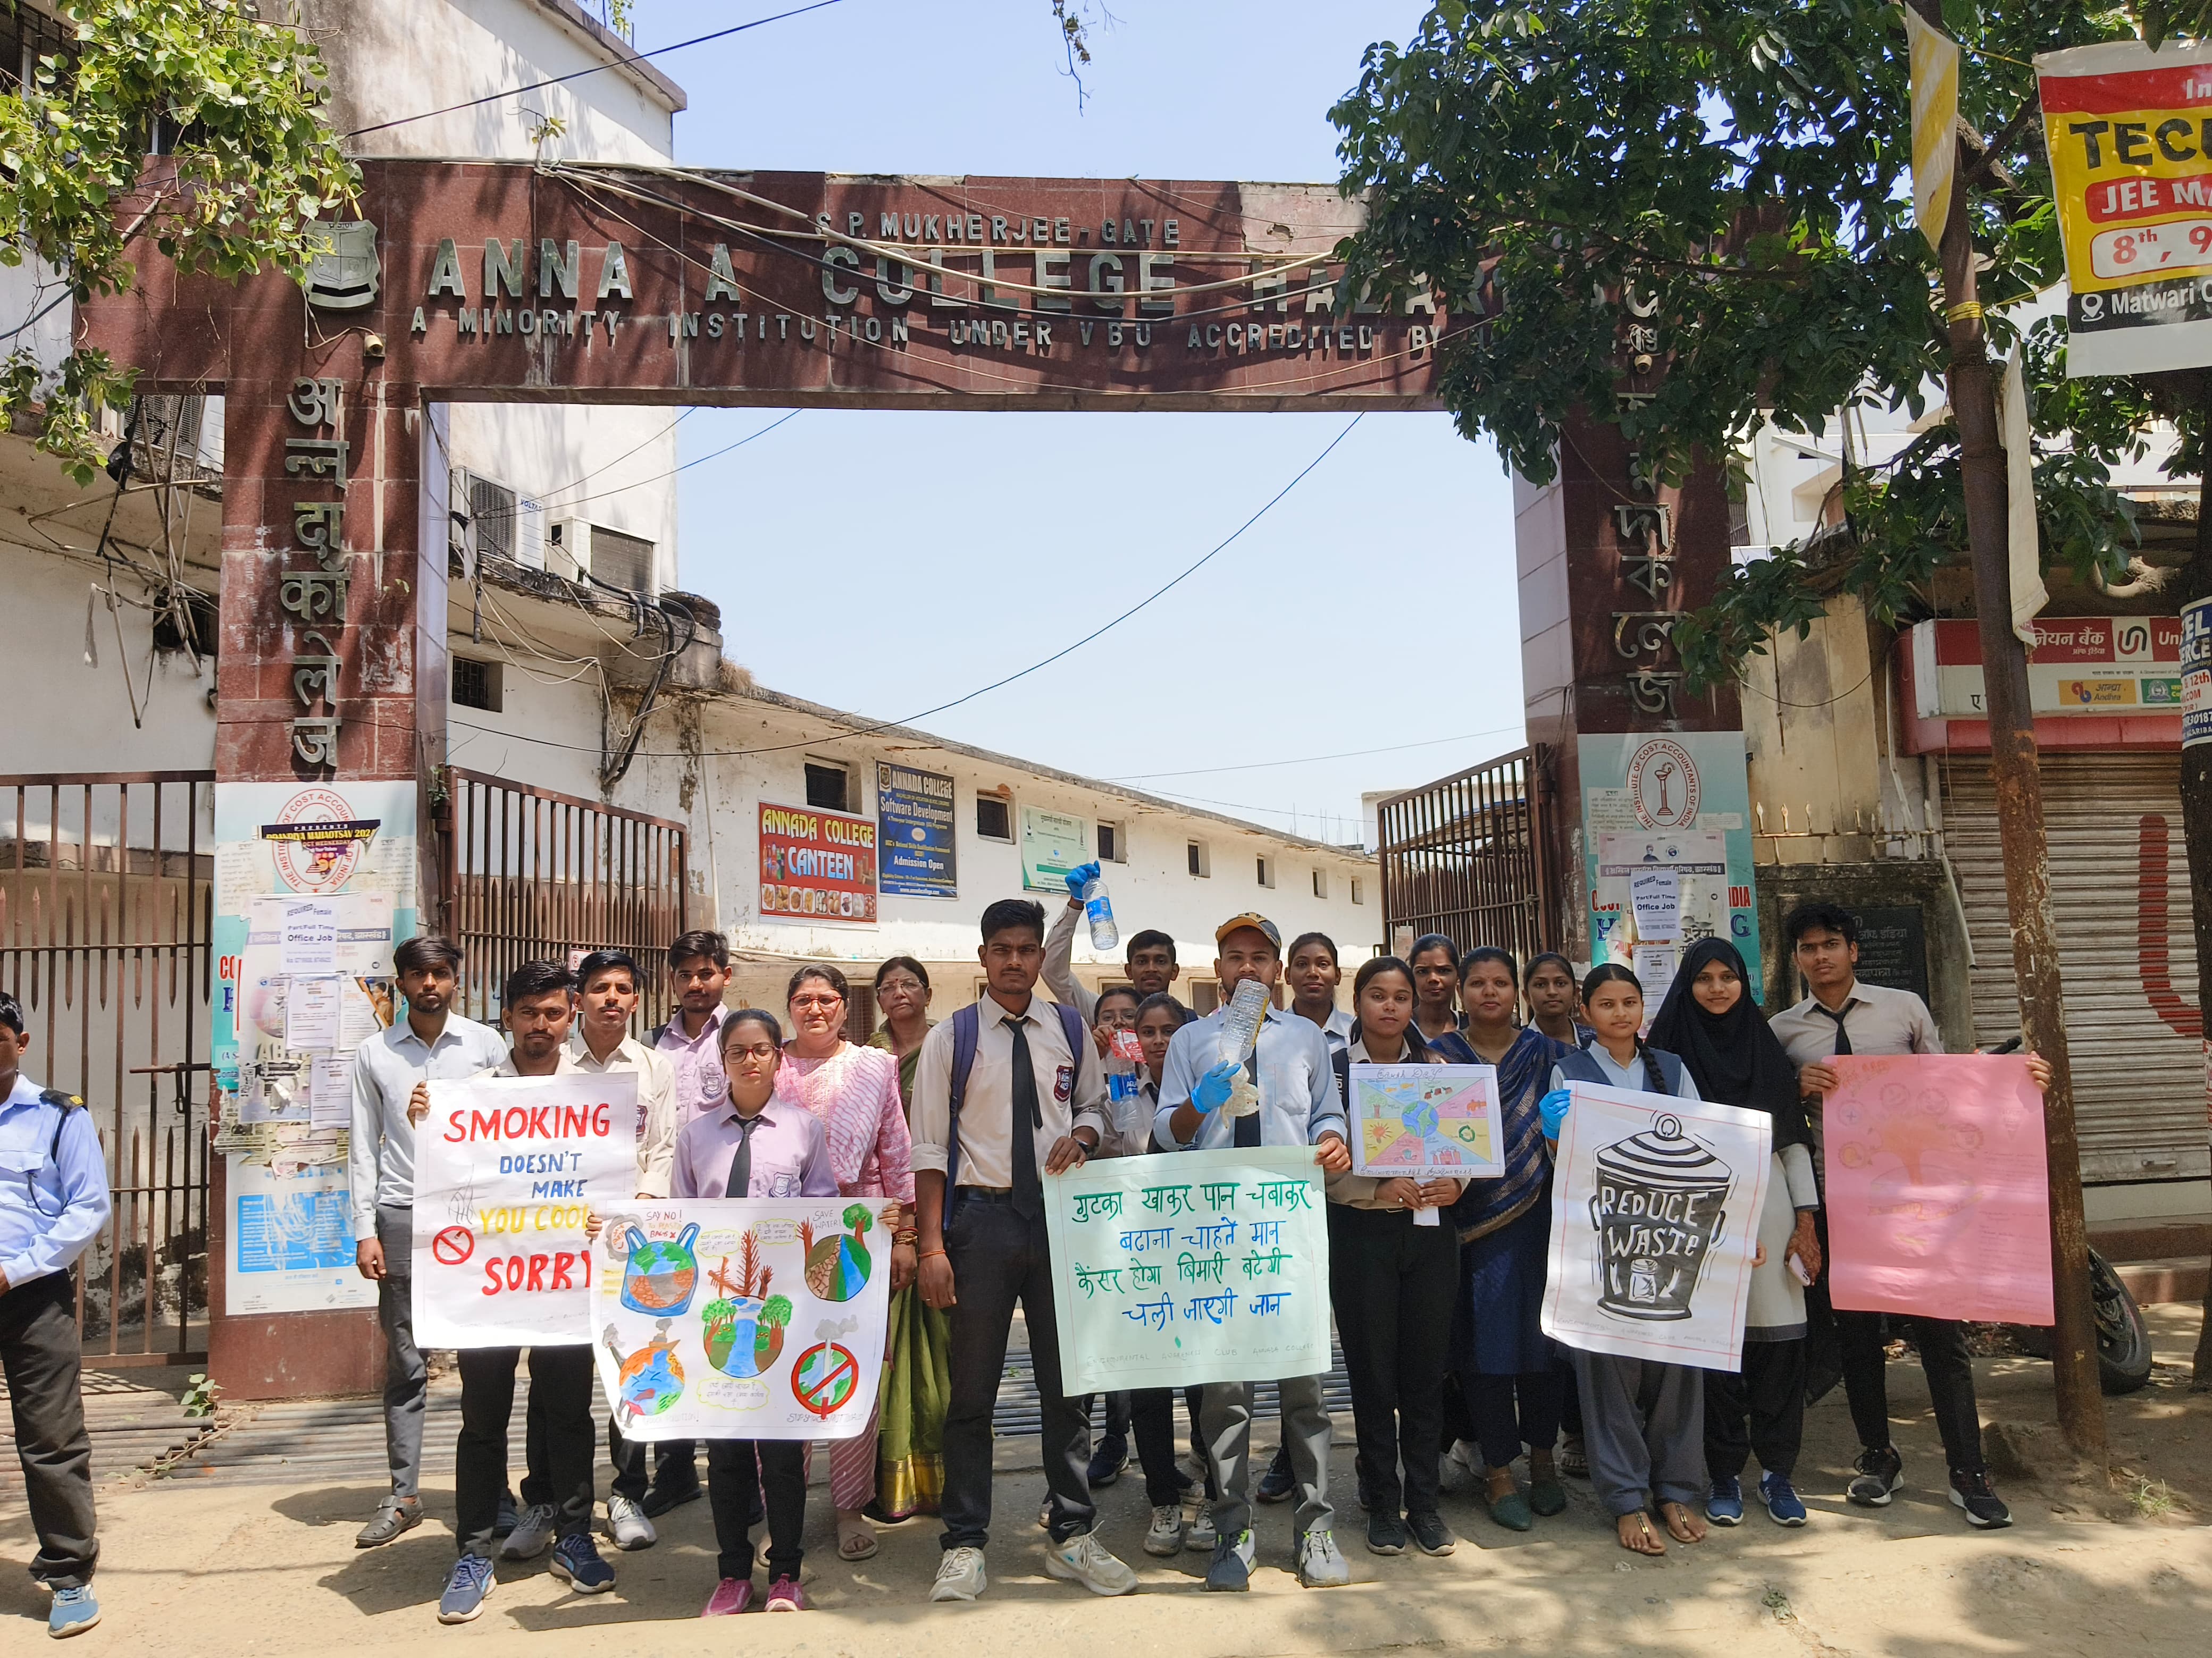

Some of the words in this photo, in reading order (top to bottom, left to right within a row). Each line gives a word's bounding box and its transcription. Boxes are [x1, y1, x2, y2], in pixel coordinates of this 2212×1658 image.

[2069, 117, 2212, 170] TEC
[2101, 180, 2159, 214] JEE
[2172, 181, 2212, 208] M
[1101, 217, 1180, 246] GATE
[822, 246, 1176, 314] COLLEGE
[2111, 281, 2194, 315] Matwari
[410, 307, 427, 333] A
[458, 308, 621, 337] MINORITY
[669, 313, 910, 344] INSTITUTION
[950, 319, 1052, 347] UNDER
[1187, 323, 1374, 351] ACCREDITED
[1410, 325, 1441, 350] BY
[2079, 626, 2106, 645] बैंक
[2158, 632, 2179, 645] Un
[2094, 693, 2121, 702] Andhra
[1639, 744, 1659, 761] COST
[892, 770, 923, 793] ANNADA
[923, 776, 953, 799] COLLEGE
[291, 794, 314, 813] COST
[881, 796, 912, 815] Software
[912, 802, 953, 823] Development
[761, 808, 818, 840] ANNADA
[825, 818, 875, 849] COLLEGE
[787, 845, 854, 881] CANTEEN
[894, 855, 927, 868] Admission
[928, 859, 944, 871] Open
[1633, 876, 1656, 888] REQUIRED
[443, 1102, 610, 1142] SMOKING
[500, 1150, 583, 1174] DOESN'T
[531, 1179, 588, 1199] MAKE
[1071, 1191, 1122, 1223] गुटका
[1200, 1182, 1241, 1211] पान
[645, 1210, 661, 1222] SAY
[812, 1209, 834, 1222] SAVE
[1600, 1185, 1711, 1227] REDUCE
[480, 1205, 526, 1235] YOU
[815, 1216, 842, 1230] WATER!
[1250, 1220, 1287, 1245] मान
[1122, 1291, 1174, 1332] चली
[1250, 1292, 1292, 1318] जान
[1214, 1348, 1238, 1357] CLUB
